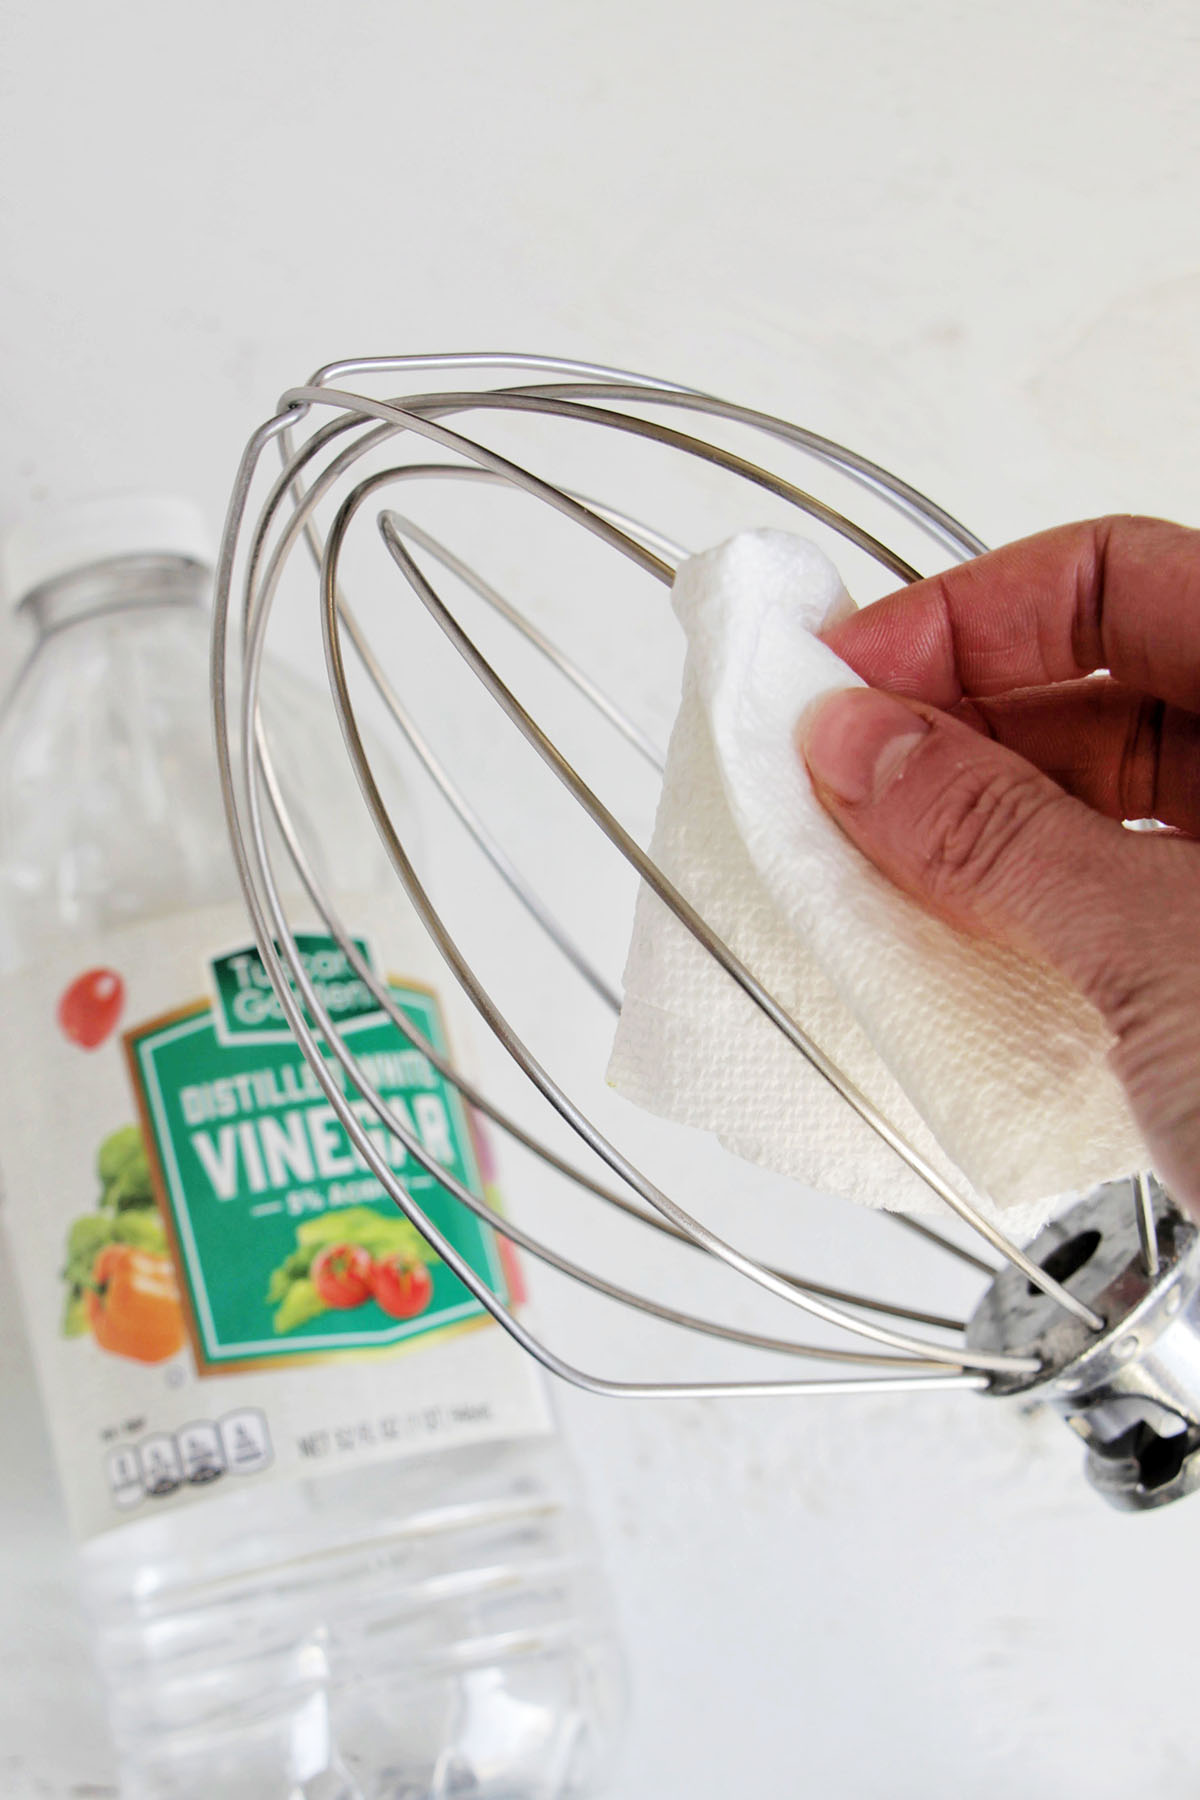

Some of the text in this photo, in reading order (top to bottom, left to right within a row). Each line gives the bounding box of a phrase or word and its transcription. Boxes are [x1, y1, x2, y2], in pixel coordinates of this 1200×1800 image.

[179, 1057, 346, 1126] DISTILLED
[191, 1093, 455, 1201] VINEGAR
[328, 1176, 409, 1206] ACIDI
